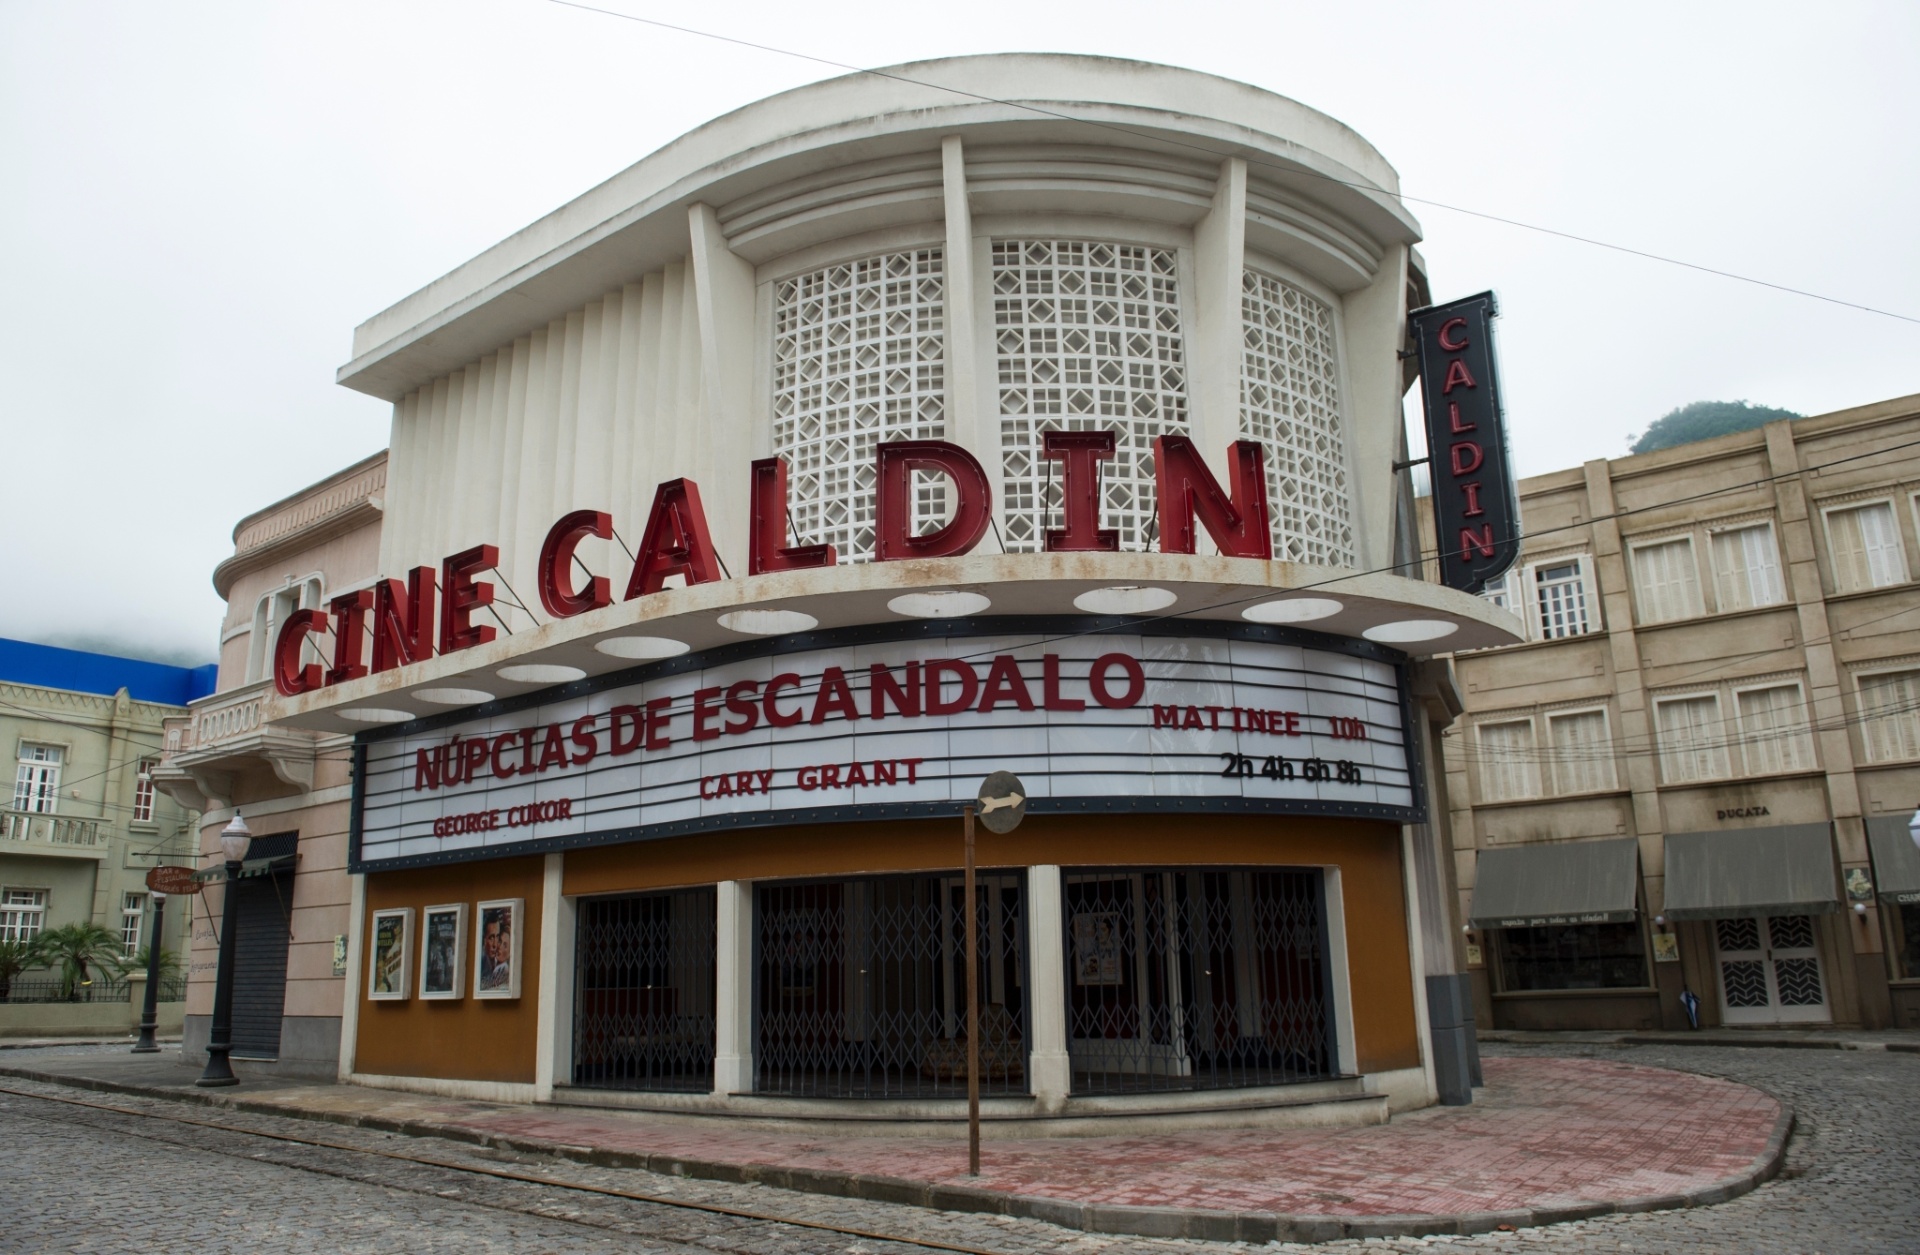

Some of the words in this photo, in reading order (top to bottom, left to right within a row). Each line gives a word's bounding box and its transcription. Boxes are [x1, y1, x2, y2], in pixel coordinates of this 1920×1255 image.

[1437, 316, 1496, 561] CALDIN
[274, 543, 499, 697] CINE
[538, 431, 1271, 619] CALDIN
[415, 715, 597, 791] NÚPCIAS
[610, 692, 673, 756] DE
[693, 653, 1145, 741] ESCANDALO
[1153, 704, 1302, 736] MATINEE
[1329, 716, 1366, 741] 10h
[700, 768, 774, 800] CARY
[797, 758, 923, 791] GRANT
[1221, 752, 1253, 778] 2h
[1261, 756, 1294, 780] 4h
[1302, 757, 1331, 782] 6h
[1336, 760, 1362, 785] 8h
[433, 809, 500, 838] GEORGE
[507, 798, 572, 828] CUKOR
[1716, 806, 1770, 820] DUCATA
